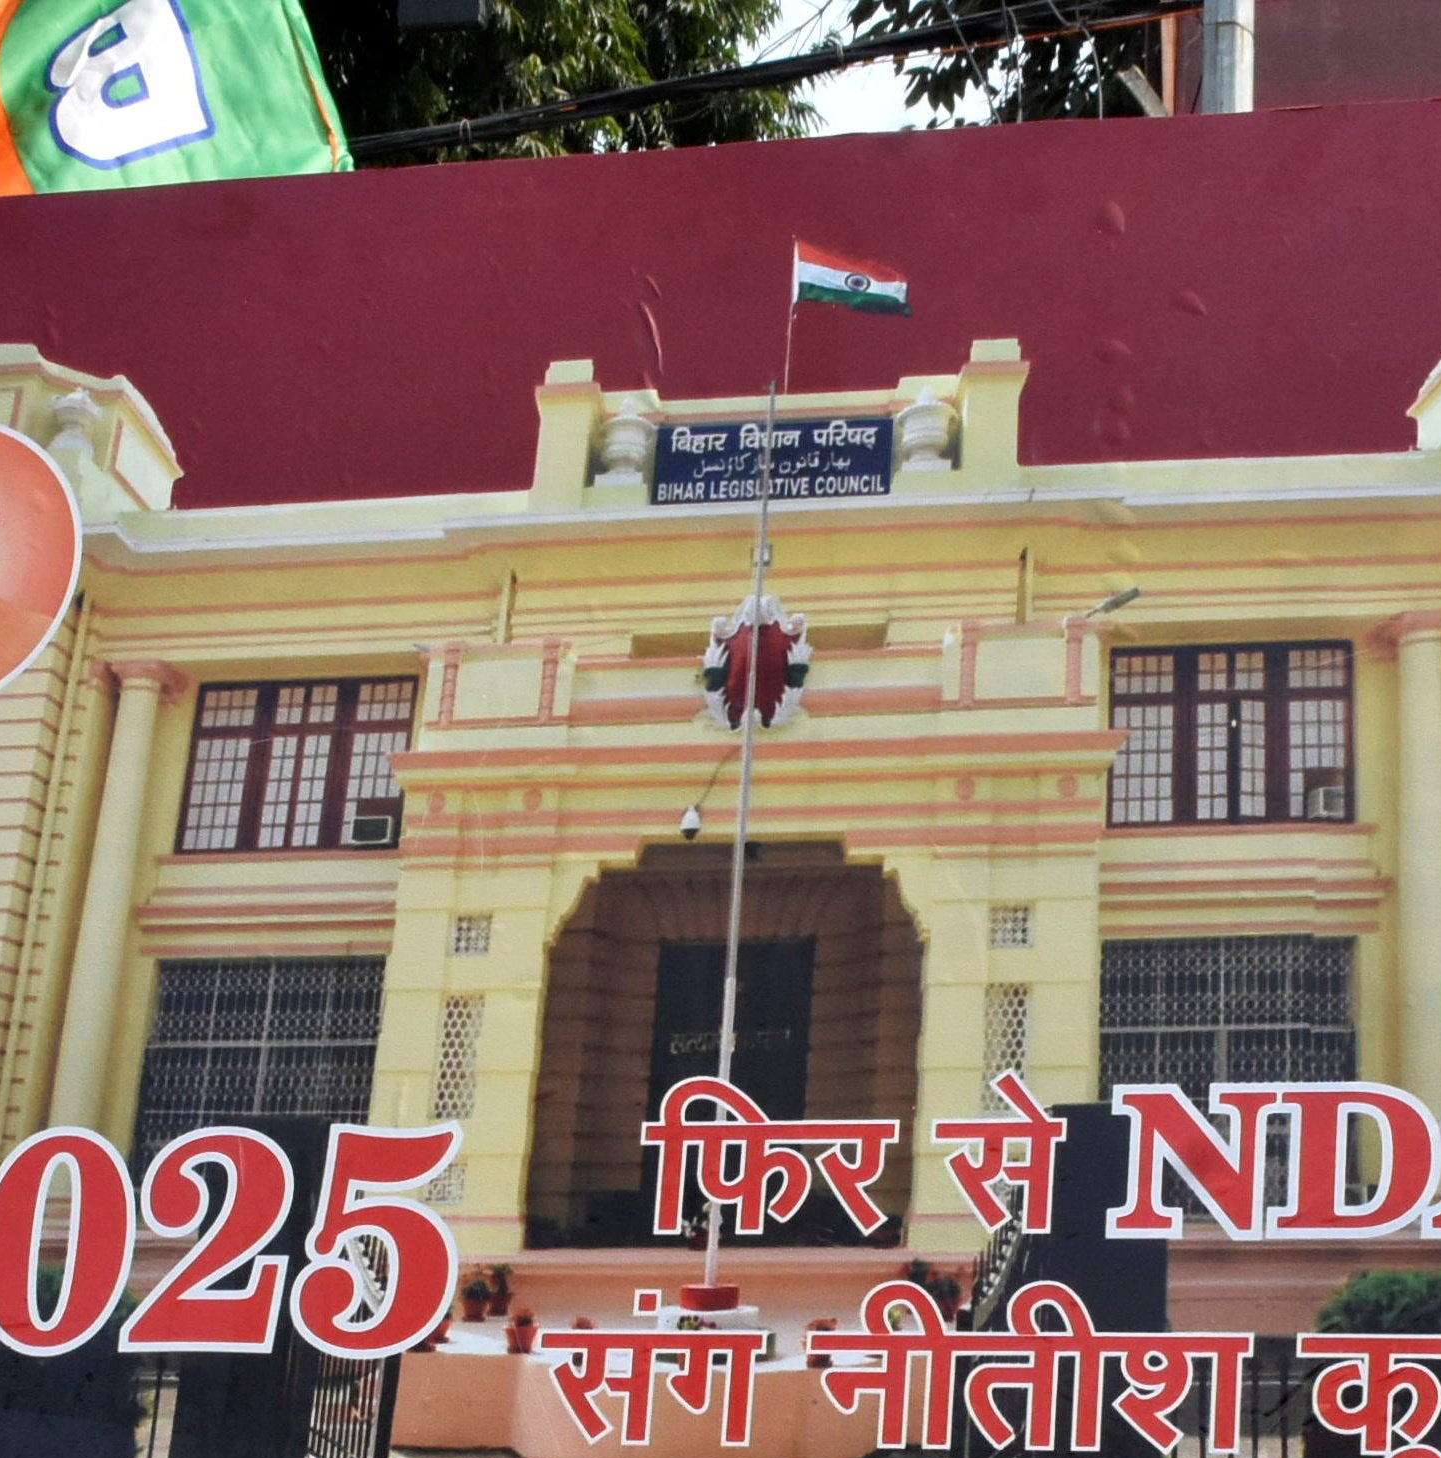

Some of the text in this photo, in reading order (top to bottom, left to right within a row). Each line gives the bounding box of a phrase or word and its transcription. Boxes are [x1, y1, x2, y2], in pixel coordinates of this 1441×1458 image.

[658, 481, 704, 500] BIHAR
[815, 474, 885, 494] COUNCIL
[672, 427, 728, 453] बिहार
[641, 1074, 900, 1235] फिर
[931, 1070, 1067, 1235] से
[540, 1289, 764, 1447] संग
[806, 1279, 1255, 1454] नीतीश
